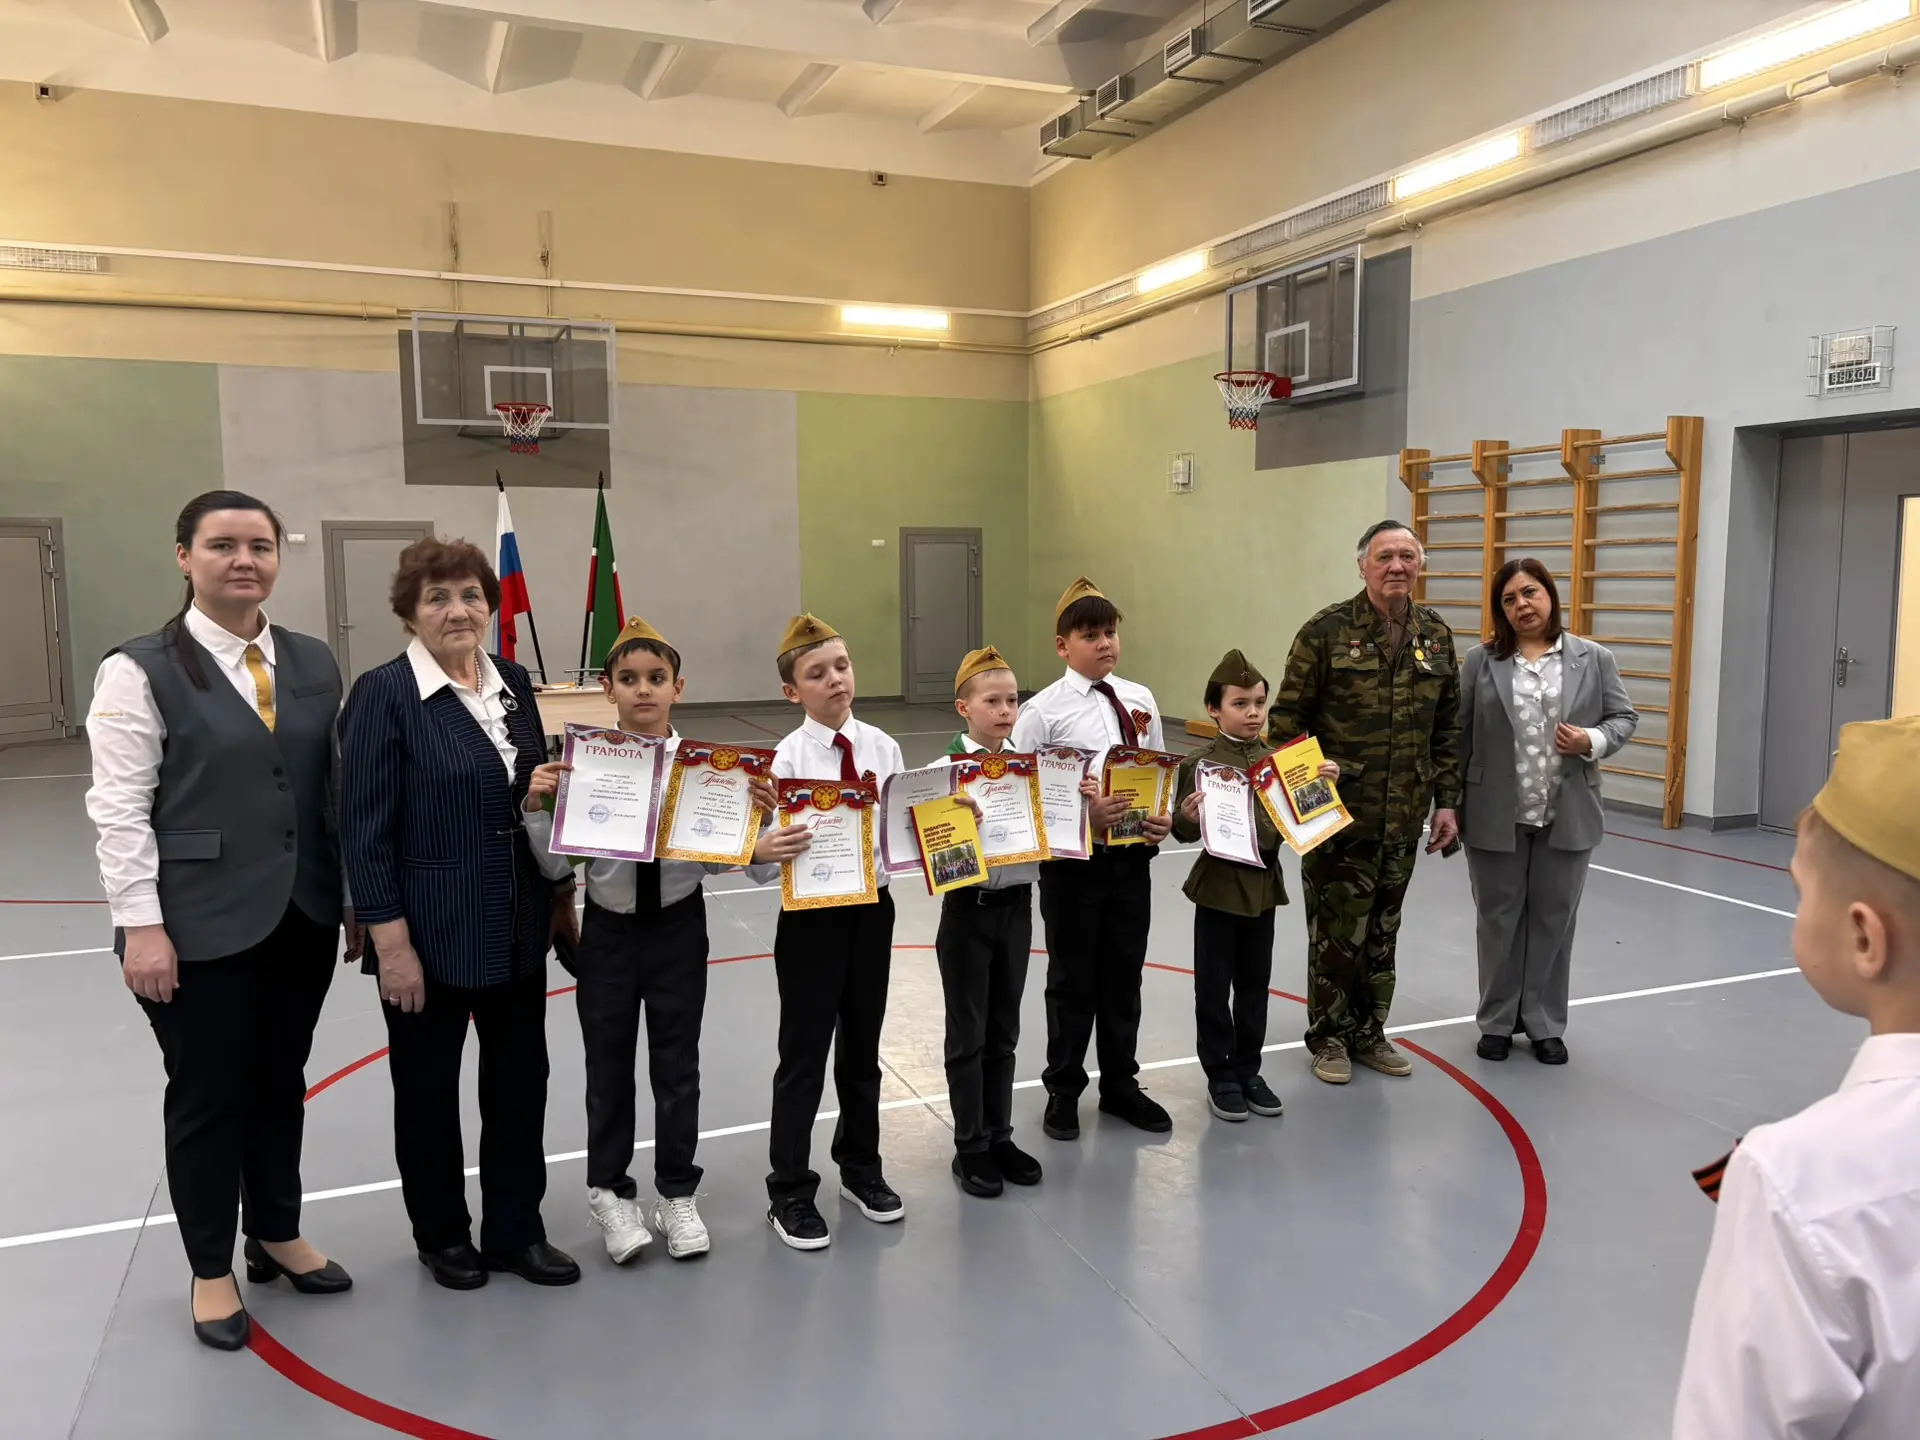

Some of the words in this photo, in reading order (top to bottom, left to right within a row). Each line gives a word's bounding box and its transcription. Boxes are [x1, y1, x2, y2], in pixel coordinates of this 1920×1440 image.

[1830, 367, 1874, 383] ВЫХОД
[585, 745, 643, 759] ГРАМОТА
[1041, 759, 1076, 772] ГРАМОТА
[901, 767, 945, 780] ГРАМОТА
[1207, 780, 1242, 794] ГРАМОТА
